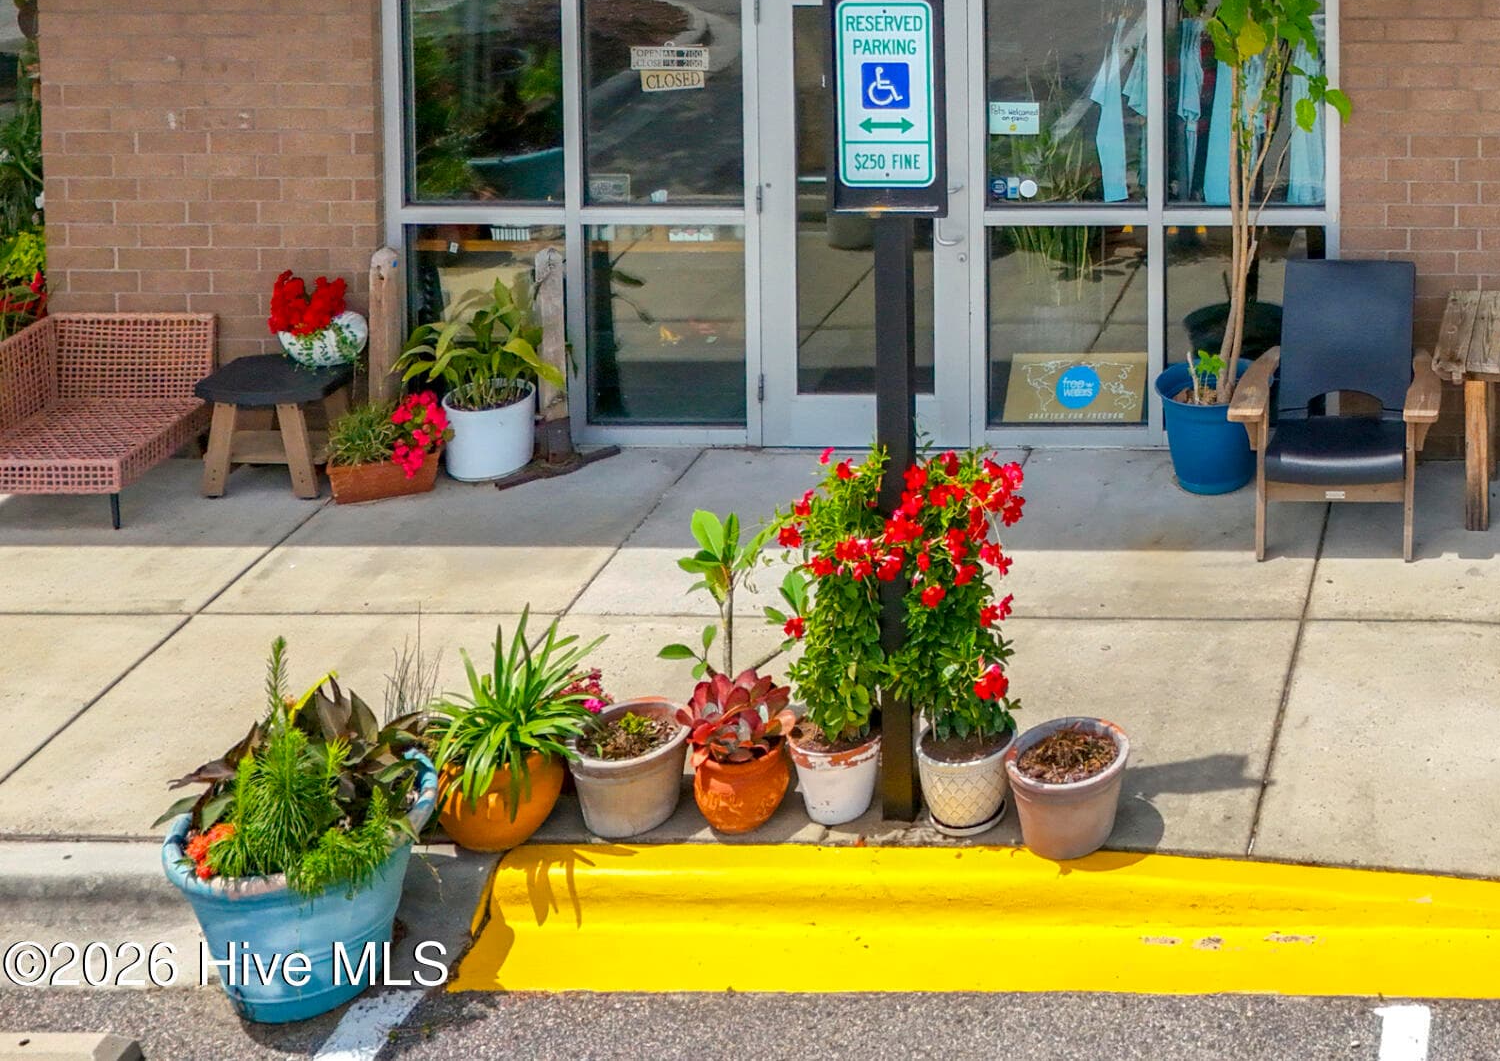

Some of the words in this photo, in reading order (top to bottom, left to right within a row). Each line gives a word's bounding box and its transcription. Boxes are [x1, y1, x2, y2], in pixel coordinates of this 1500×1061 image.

[845, 15, 923, 32] RESERVED
[853, 38, 917, 55] PARKING
[646, 72, 701, 89] CLOSED
[854, 152, 886, 171] $250
[892, 154, 921, 170] FINE
[1062, 377, 1085, 388] free
